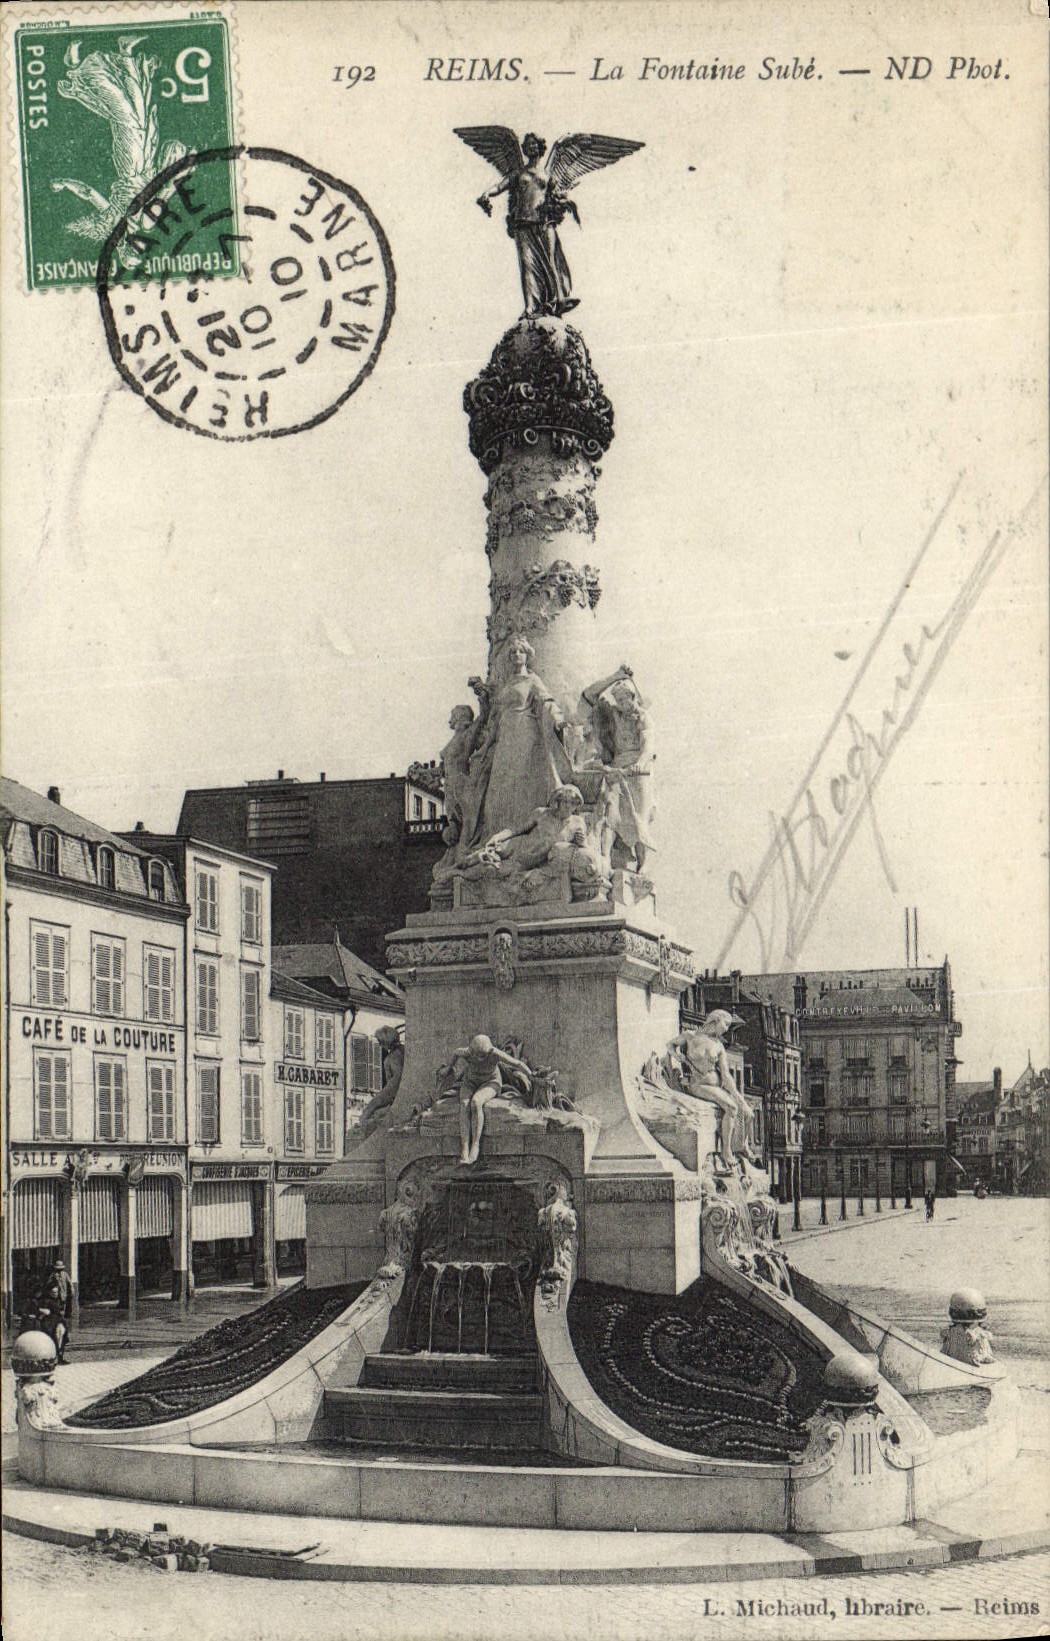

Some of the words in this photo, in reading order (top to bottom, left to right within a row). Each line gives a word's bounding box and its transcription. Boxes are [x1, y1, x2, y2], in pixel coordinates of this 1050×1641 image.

[26, 44, 49, 130] POSTES
[37, 258, 119, 281] FANÇAISE
[295, 177, 380, 352] MARNE
[22, 1015, 63, 1041] CAFÉ
[71, 1026, 87, 1044] DE
[94, 1029, 107, 1046] LA
[113, 1026, 176, 1053] COUTURE
[12, 1151, 58, 1167] SALLE
